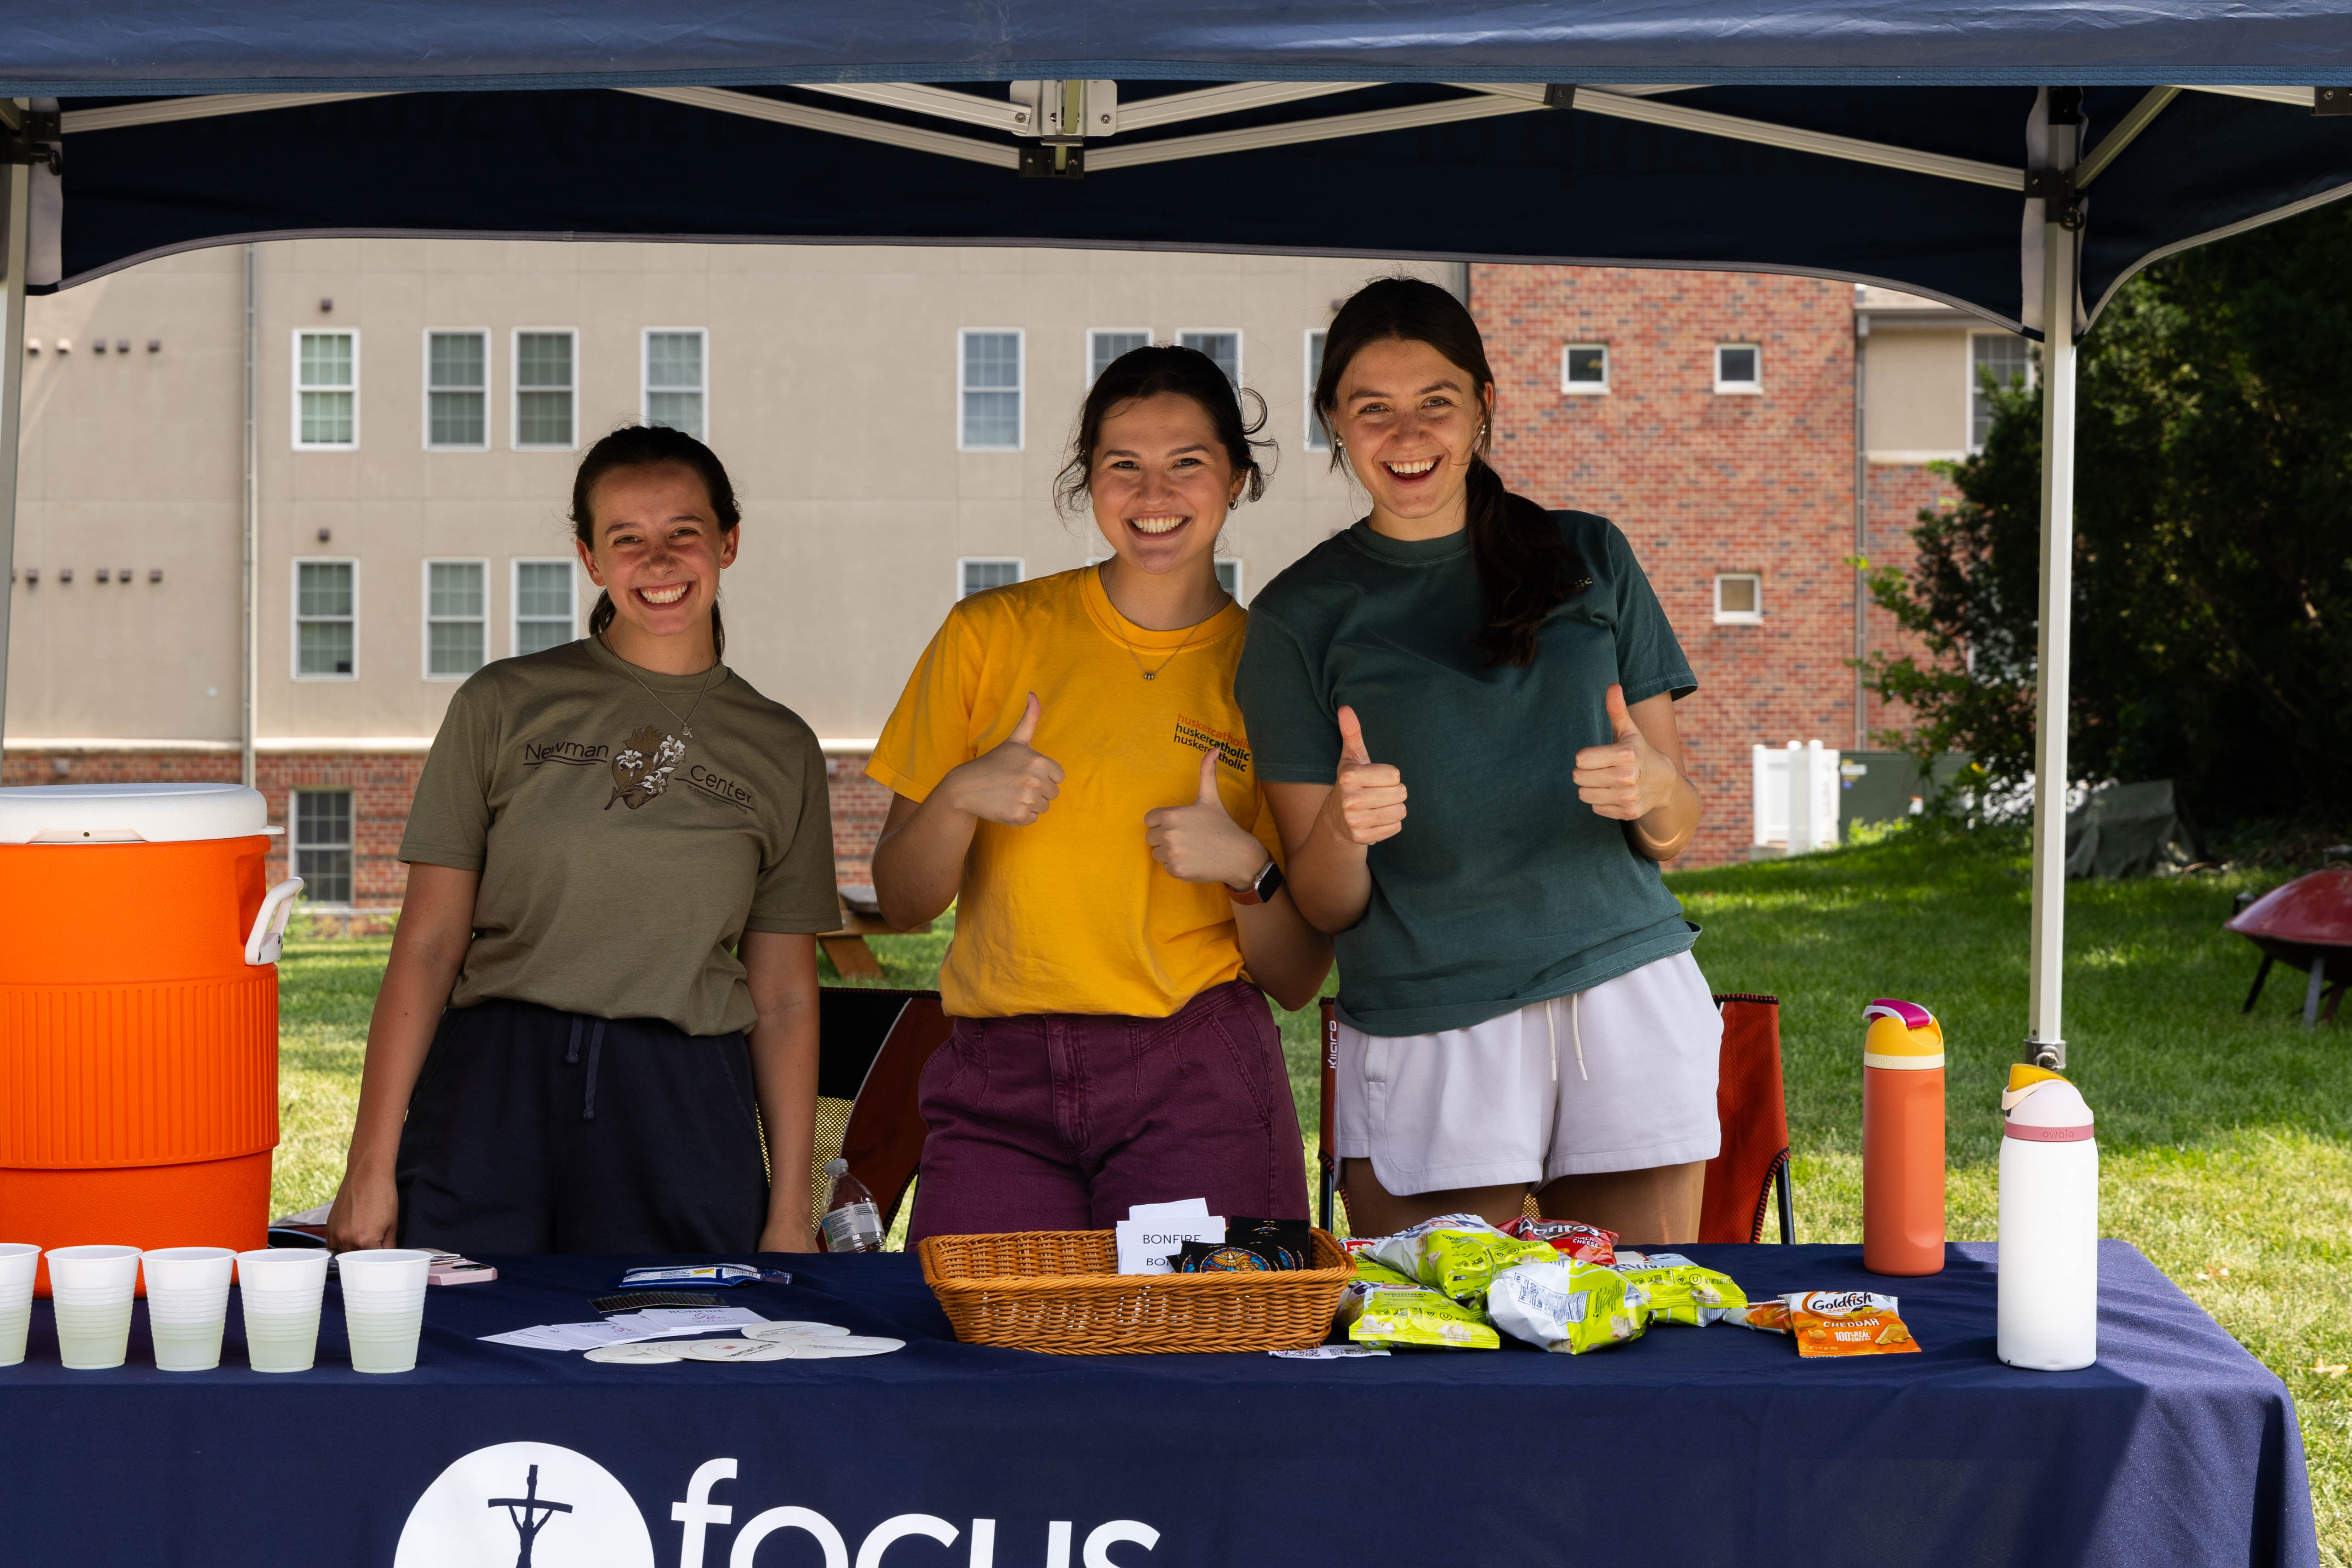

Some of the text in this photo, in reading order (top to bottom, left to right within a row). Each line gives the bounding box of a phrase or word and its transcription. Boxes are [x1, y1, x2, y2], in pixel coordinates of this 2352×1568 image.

[1175, 722, 1250, 761] huskercatholic
[1173, 732, 1247, 772] huskertholic
[525, 741, 752, 803] Newman Center
[1869, 1058, 1894, 1067] owala
[2042, 1129, 2074, 1139] owala
[1519, 1219, 1599, 1237] Doritos
[1143, 1234, 1202, 1244] BONFIRE
[1573, 1238, 1599, 1248] CHEESE
[1812, 1292, 1872, 1310] Goldfish
[1823, 1318, 1880, 1328] CHEDDAR
[1834, 1331, 1854, 1342] 100%
